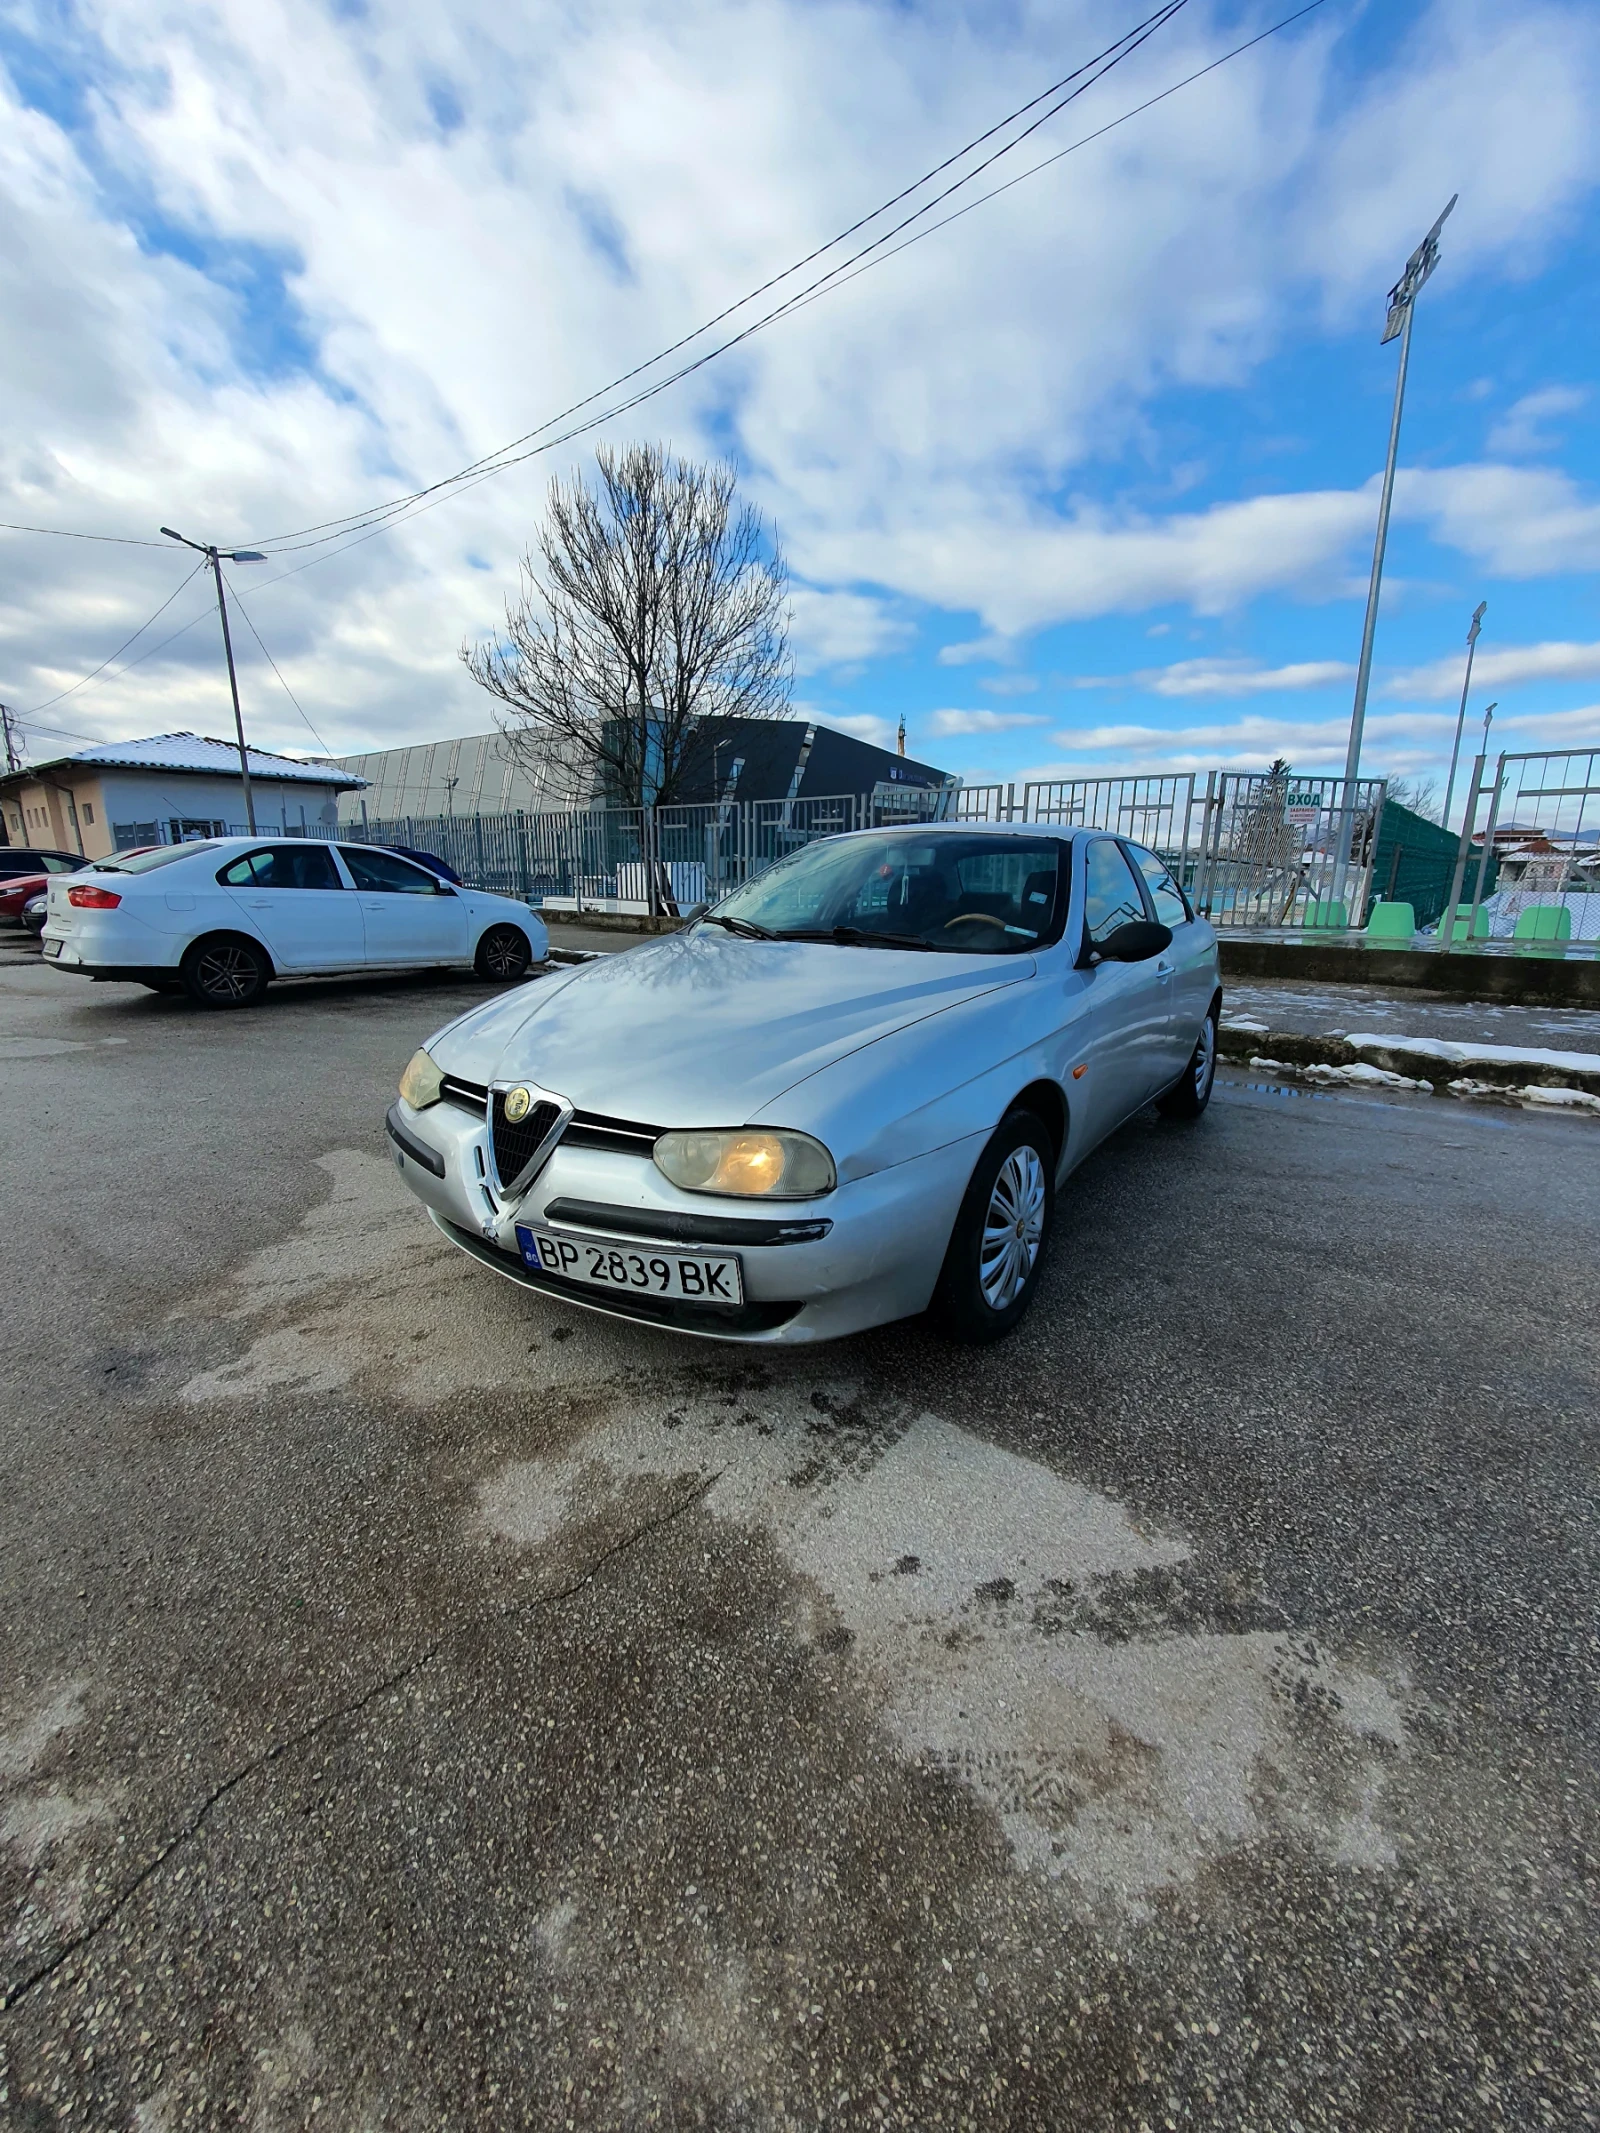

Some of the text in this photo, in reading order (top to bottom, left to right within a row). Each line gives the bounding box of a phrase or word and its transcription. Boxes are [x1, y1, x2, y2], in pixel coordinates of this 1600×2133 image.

[1288, 794, 1320, 807] ВХОД
[525, 1251, 538, 1263] BG
[537, 1237, 733, 1298] BP 2839 BK
